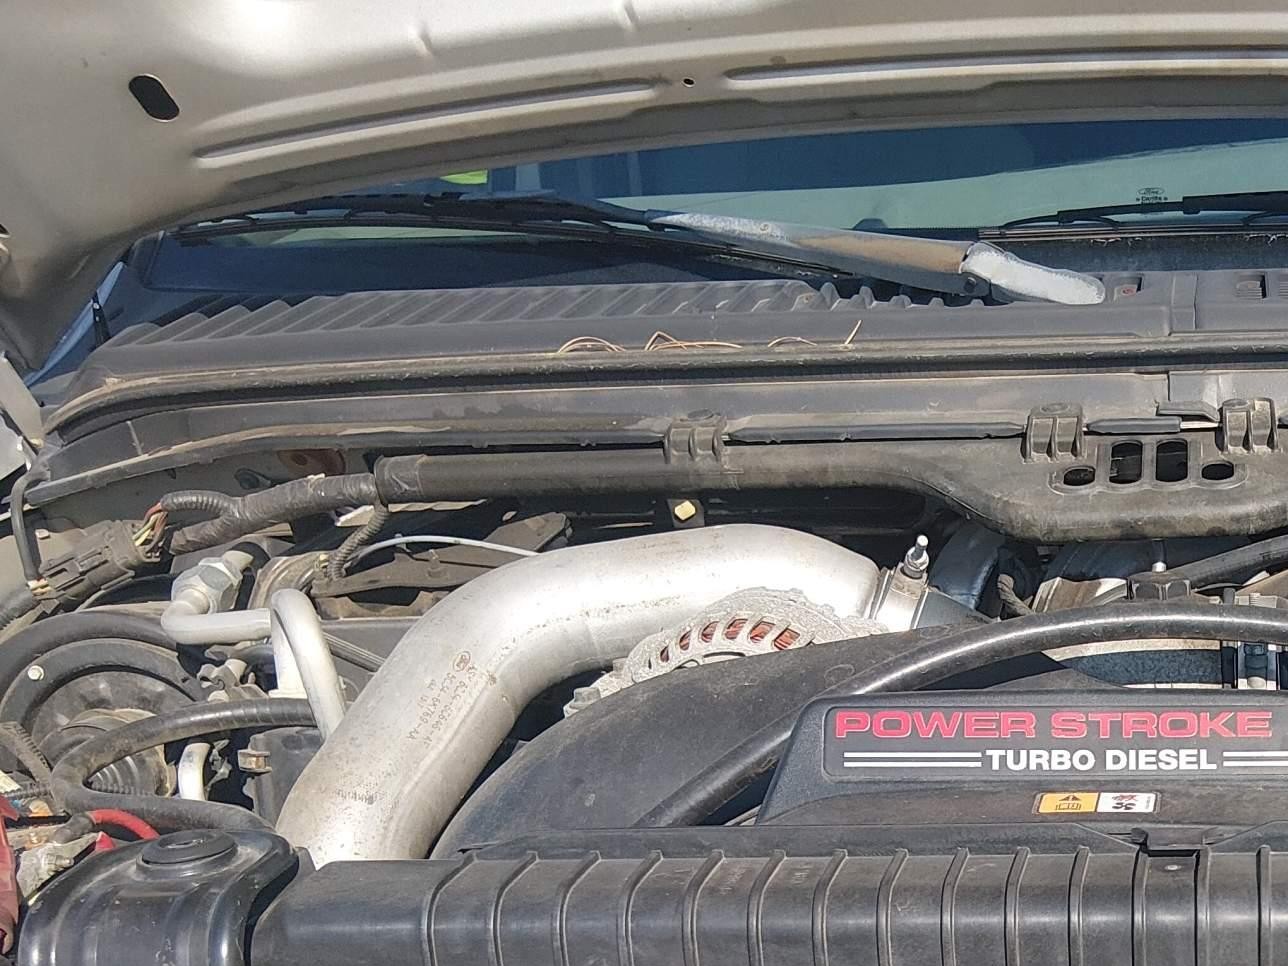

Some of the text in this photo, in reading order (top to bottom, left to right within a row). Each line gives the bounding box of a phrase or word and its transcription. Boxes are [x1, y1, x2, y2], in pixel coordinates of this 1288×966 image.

[835, 710, 1036, 739] POWER
[1050, 710, 1273, 739] STROKE
[985, 749, 1218, 771] TURBO DIESEL
